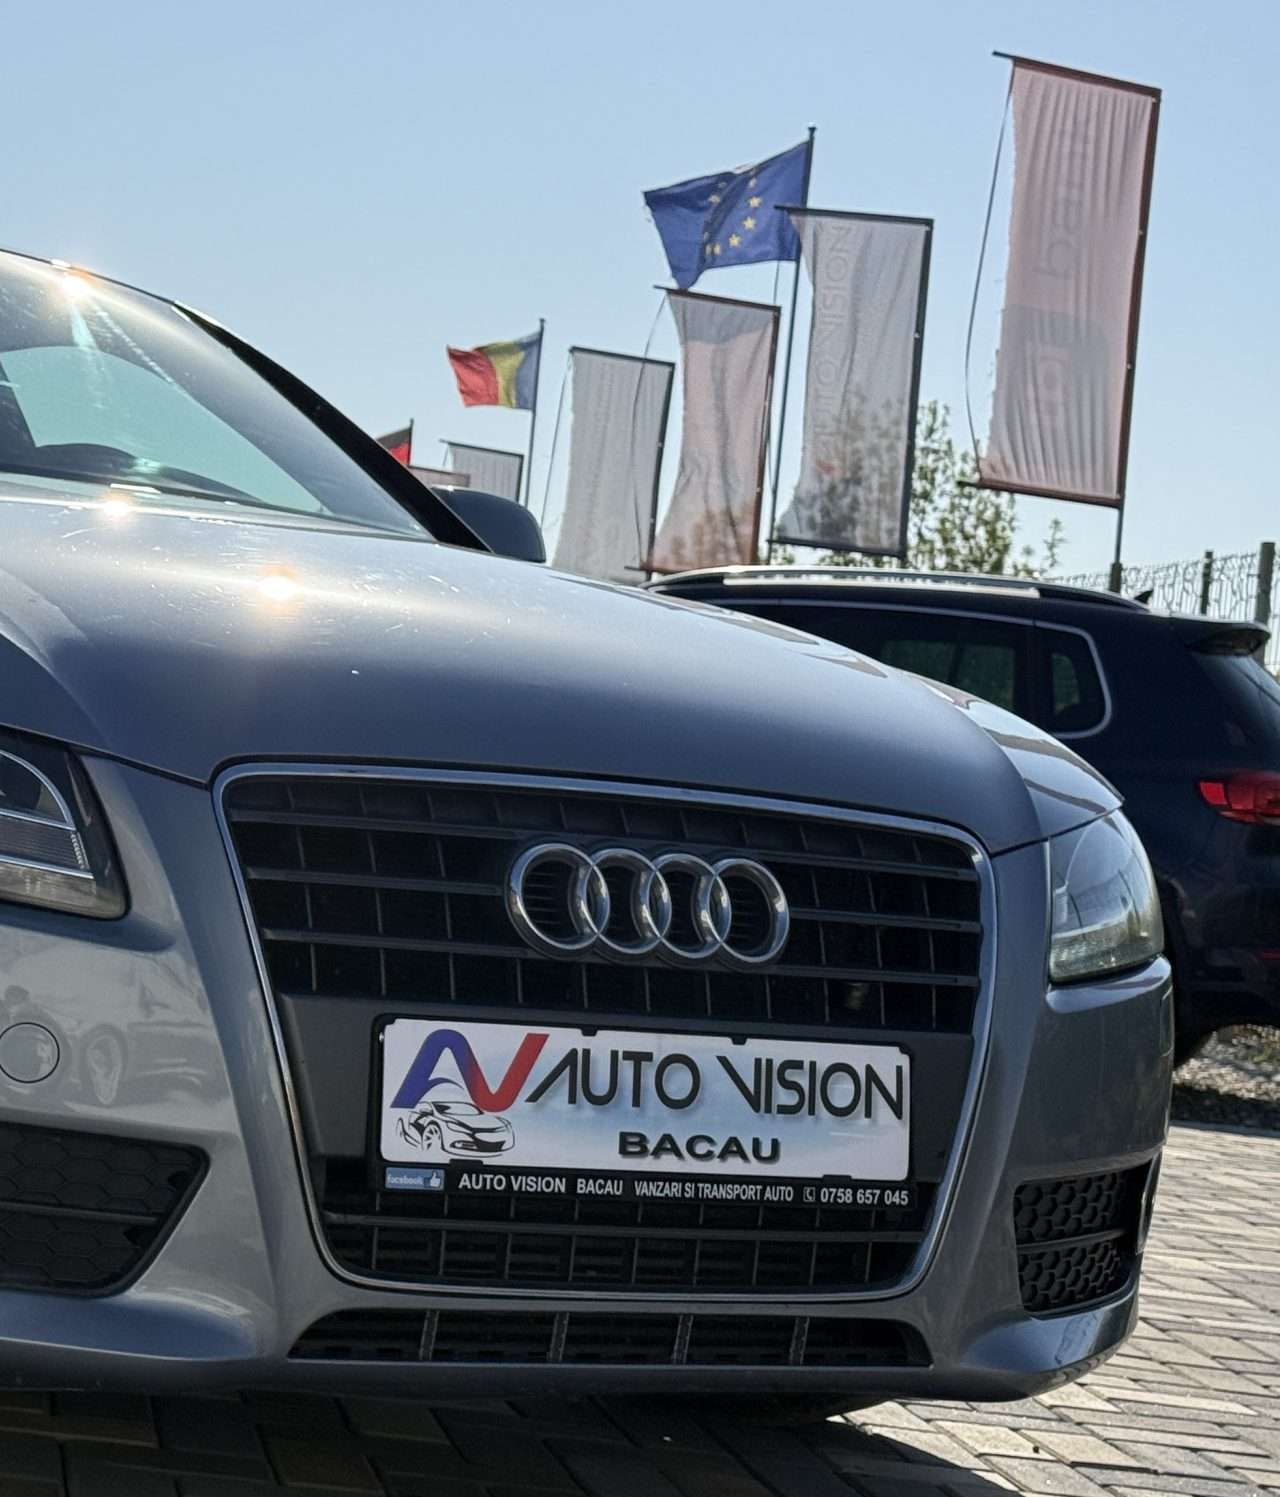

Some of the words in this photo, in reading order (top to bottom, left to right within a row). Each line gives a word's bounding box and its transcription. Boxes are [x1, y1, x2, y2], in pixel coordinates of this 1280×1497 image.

[817, 226, 851, 346] VISION
[525, 1048, 701, 1110] AUTO
[716, 1055, 903, 1120] VISION
[618, 1132, 781, 1164] BACAU
[458, 1173, 506, 1191] AUTO
[510, 1175, 566, 1193] VISION
[576, 1178, 623, 1196] BACAU
[634, 1180, 682, 1198] VANZARI
[684, 1181, 695, 1198] SI
[697, 1182, 763, 1201] TRANSPORT
[763, 1185, 794, 1201] AUTO
[820, 1187, 853, 1204] 0758
[856, 1188, 880, 1205] 657
[884, 1189, 909, 1206] 045
